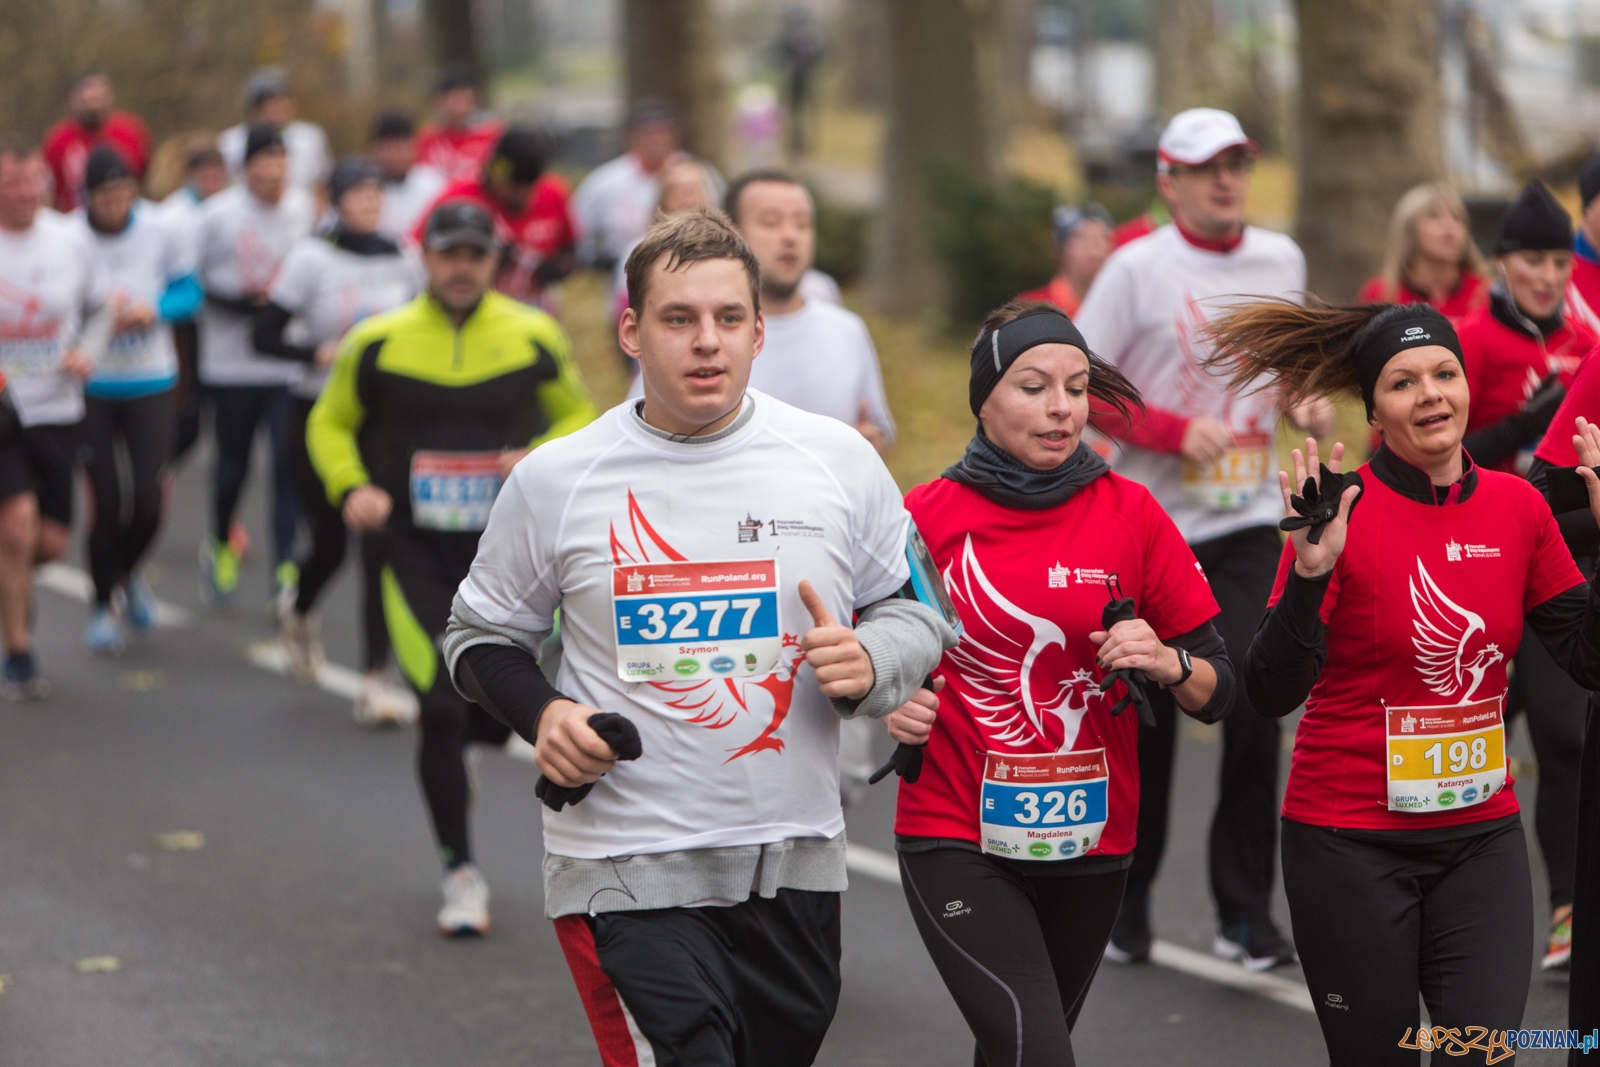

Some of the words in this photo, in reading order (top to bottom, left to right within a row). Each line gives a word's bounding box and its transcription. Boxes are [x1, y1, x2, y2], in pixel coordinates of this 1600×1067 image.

[768, 519, 778, 536] 1
[1464, 544, 1472, 558] 1
[648, 574, 656, 587] 1
[700, 573, 766, 584] RunPoland.org
[1073, 568, 1084, 584] 1
[620, 616, 632, 629] E
[636, 598, 762, 640] 3277
[679, 646, 719, 656] Szymon
[626, 668, 656, 676] LUXMED
[1420, 717, 1426, 729] 1
[1462, 711, 1497, 724] RunPoland.org
[1392, 754, 1404, 766] D
[1424, 737, 1487, 775] 198
[1012, 766, 1019, 777] 1
[1056, 764, 1100, 774] RunPoland.org
[1437, 779, 1473, 788] Katarzyna
[985, 798, 995, 810] E
[1014, 789, 1087, 824] 326
[1027, 830, 1073, 840] Magdalena
[988, 838, 1008, 847] GRUPA
[988, 844, 1011, 854] LUXMED
[942, 906, 972, 918] Kalenji
